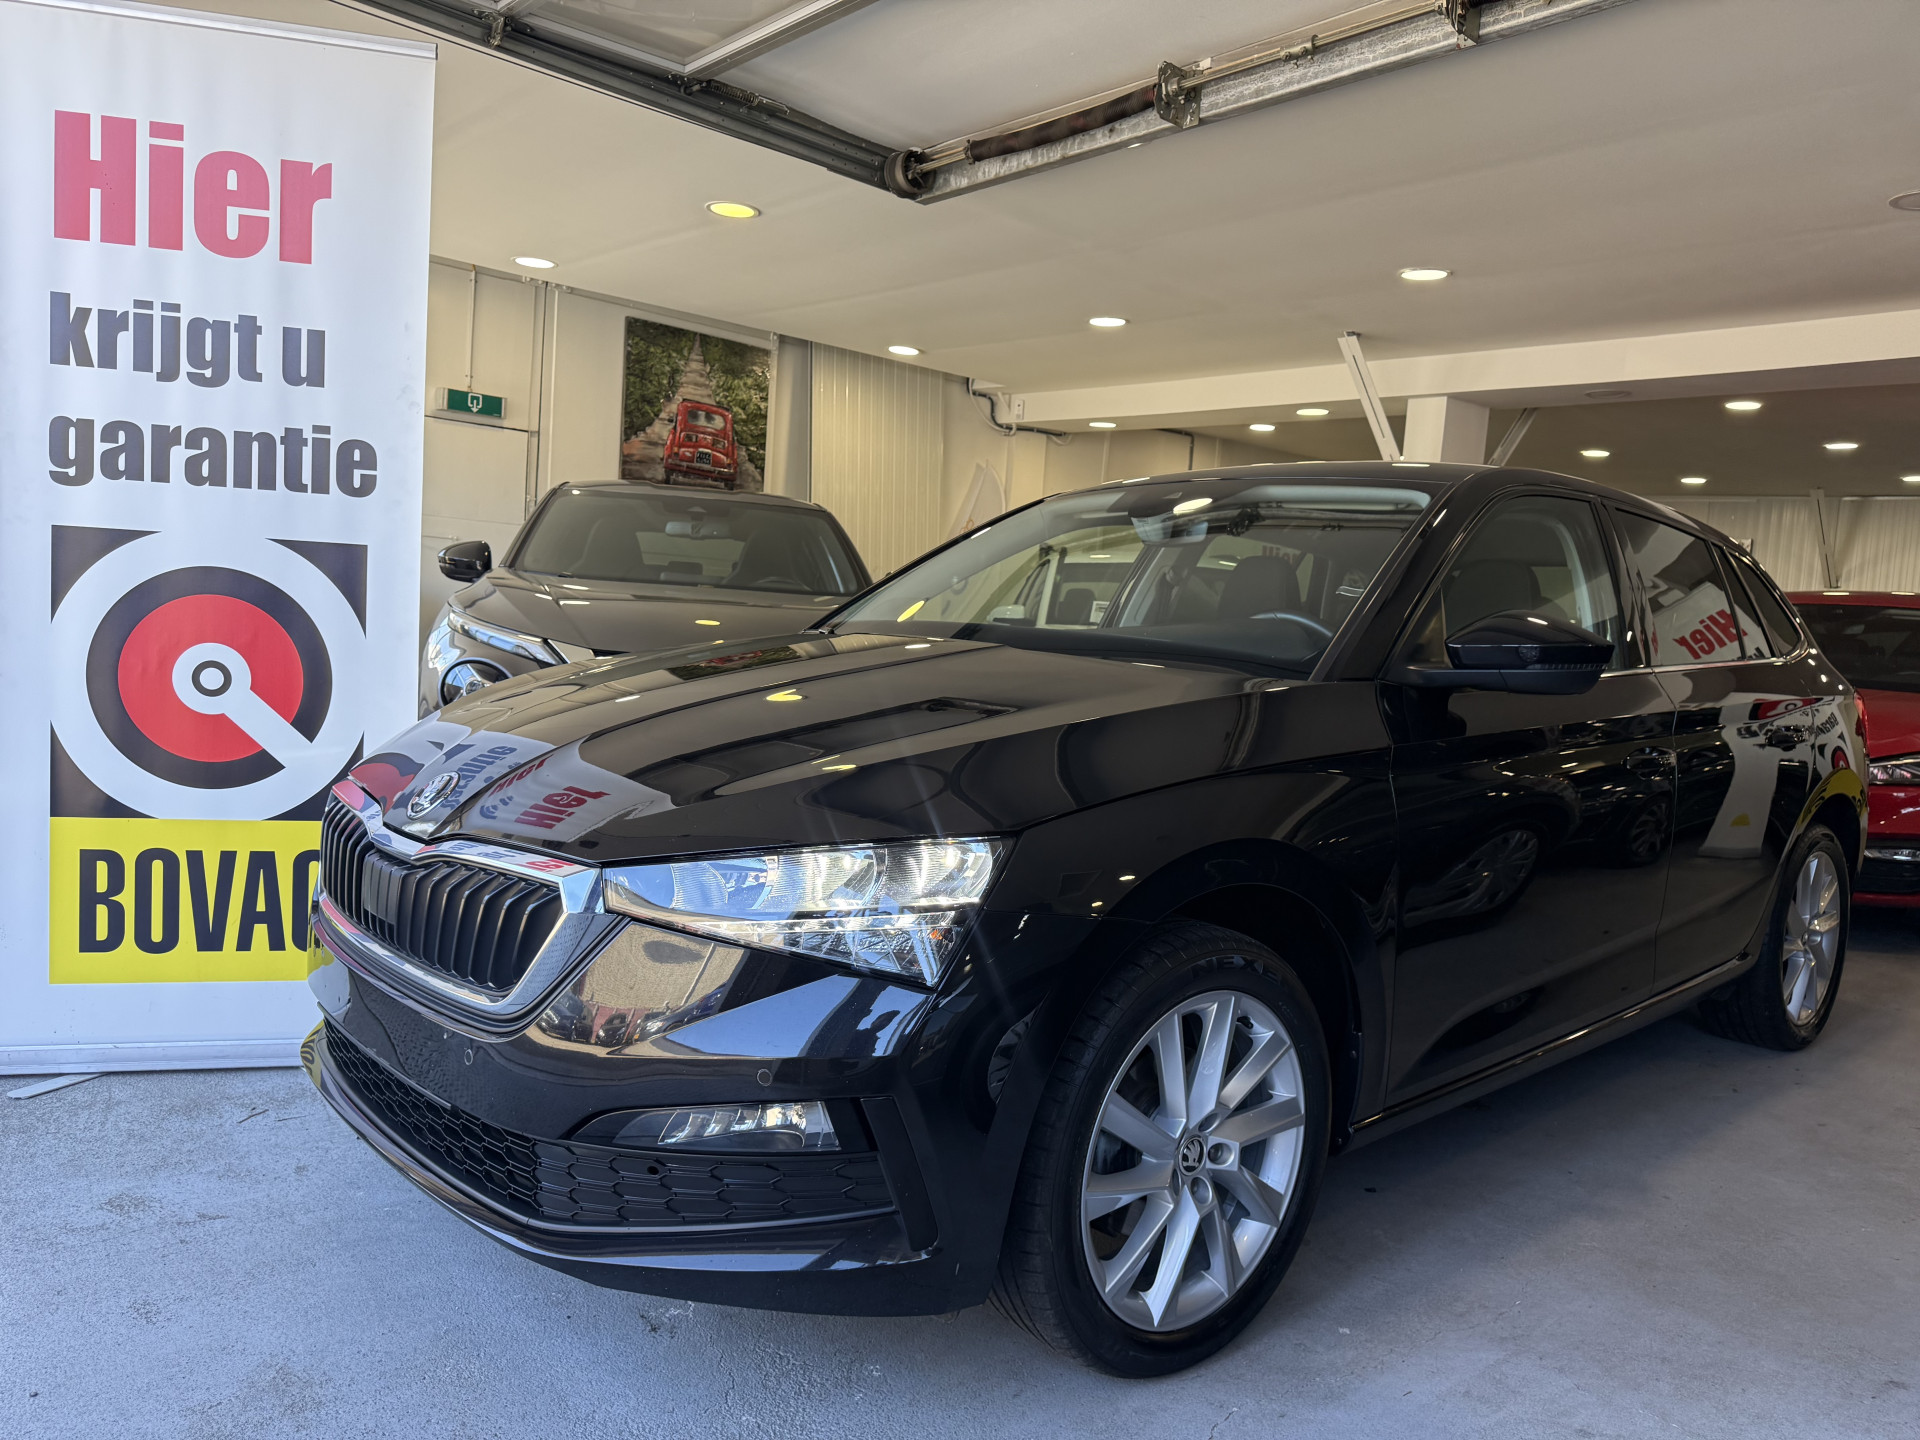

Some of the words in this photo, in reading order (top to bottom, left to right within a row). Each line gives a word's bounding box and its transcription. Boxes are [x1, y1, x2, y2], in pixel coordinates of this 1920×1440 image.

[54, 109, 332, 264] Hier
[49, 290, 262, 388] krijgt
[282, 326, 325, 388] u
[48, 415, 377, 498] garantie
